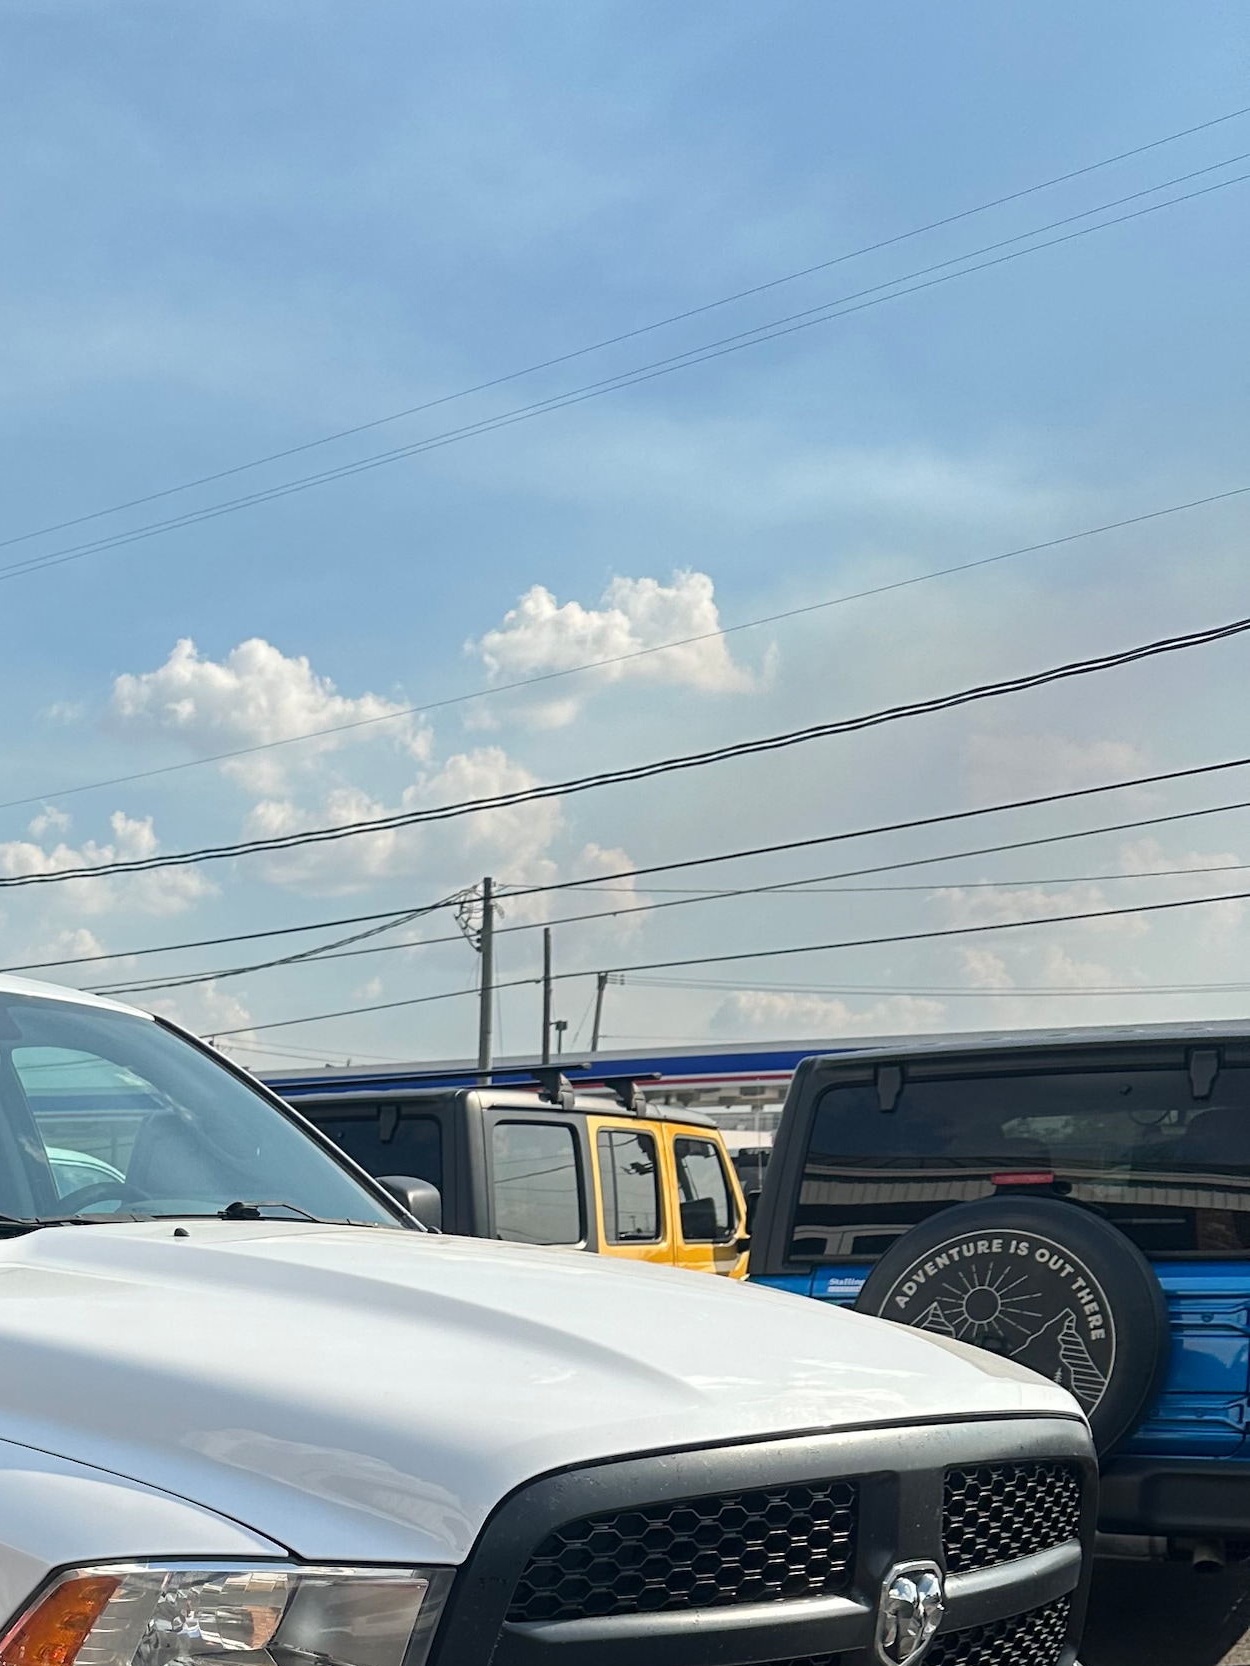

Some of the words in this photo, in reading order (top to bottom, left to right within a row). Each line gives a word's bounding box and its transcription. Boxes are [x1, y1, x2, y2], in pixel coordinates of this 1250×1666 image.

[895, 1238, 1004, 1309] ADVENTURE
[1009, 1239, 1030, 1256] IS
[1035, 1248, 1075, 1278] OUT
[1071, 1276, 1106, 1341] THERE
